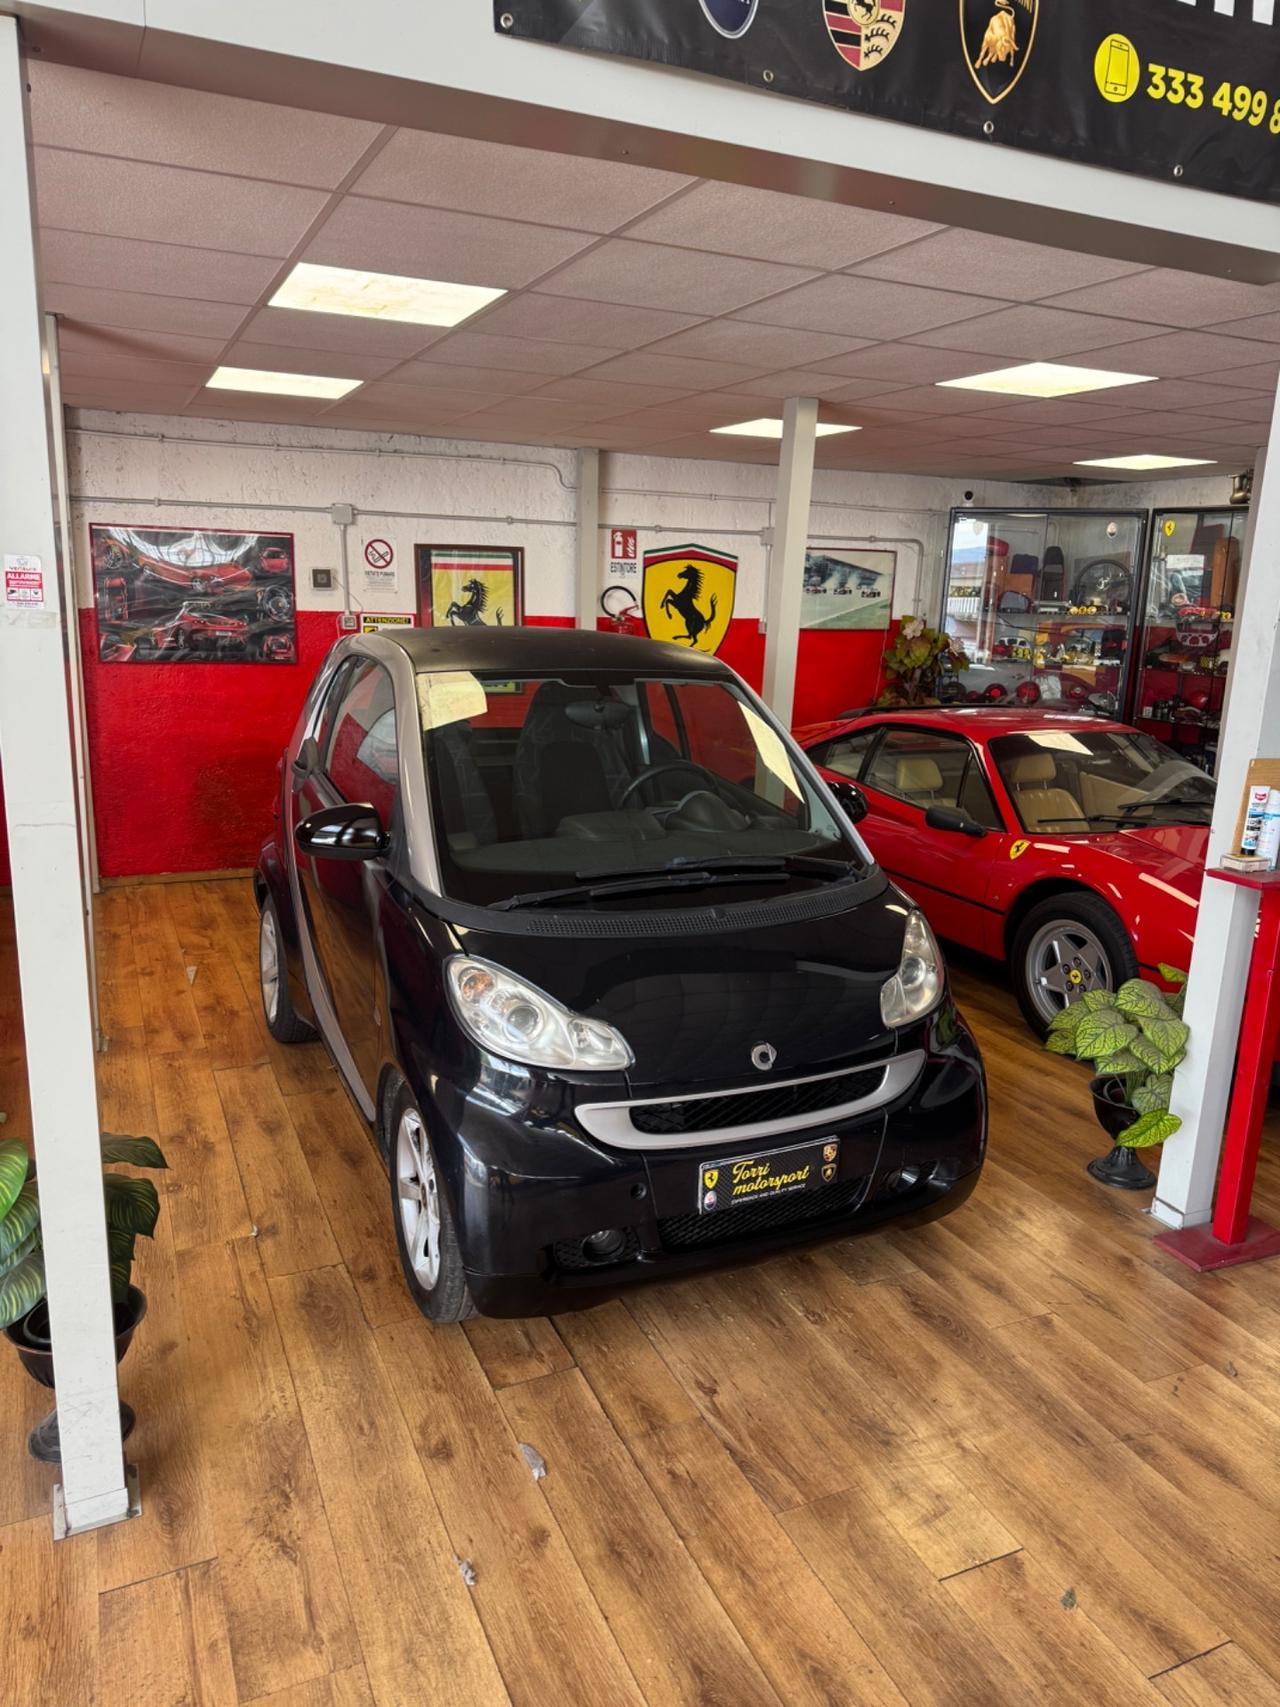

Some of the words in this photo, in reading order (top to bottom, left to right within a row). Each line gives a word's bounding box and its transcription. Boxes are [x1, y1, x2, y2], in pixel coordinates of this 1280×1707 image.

[1147, 63, 1204, 108] 333
[1212, 82, 1267, 126] 499
[7, 572, 40, 580] ALLARME
[610, 561, 637, 573] ESTINTORE
[732, 1161, 769, 1183] Torri
[732, 1166, 809, 1195] motorsport
